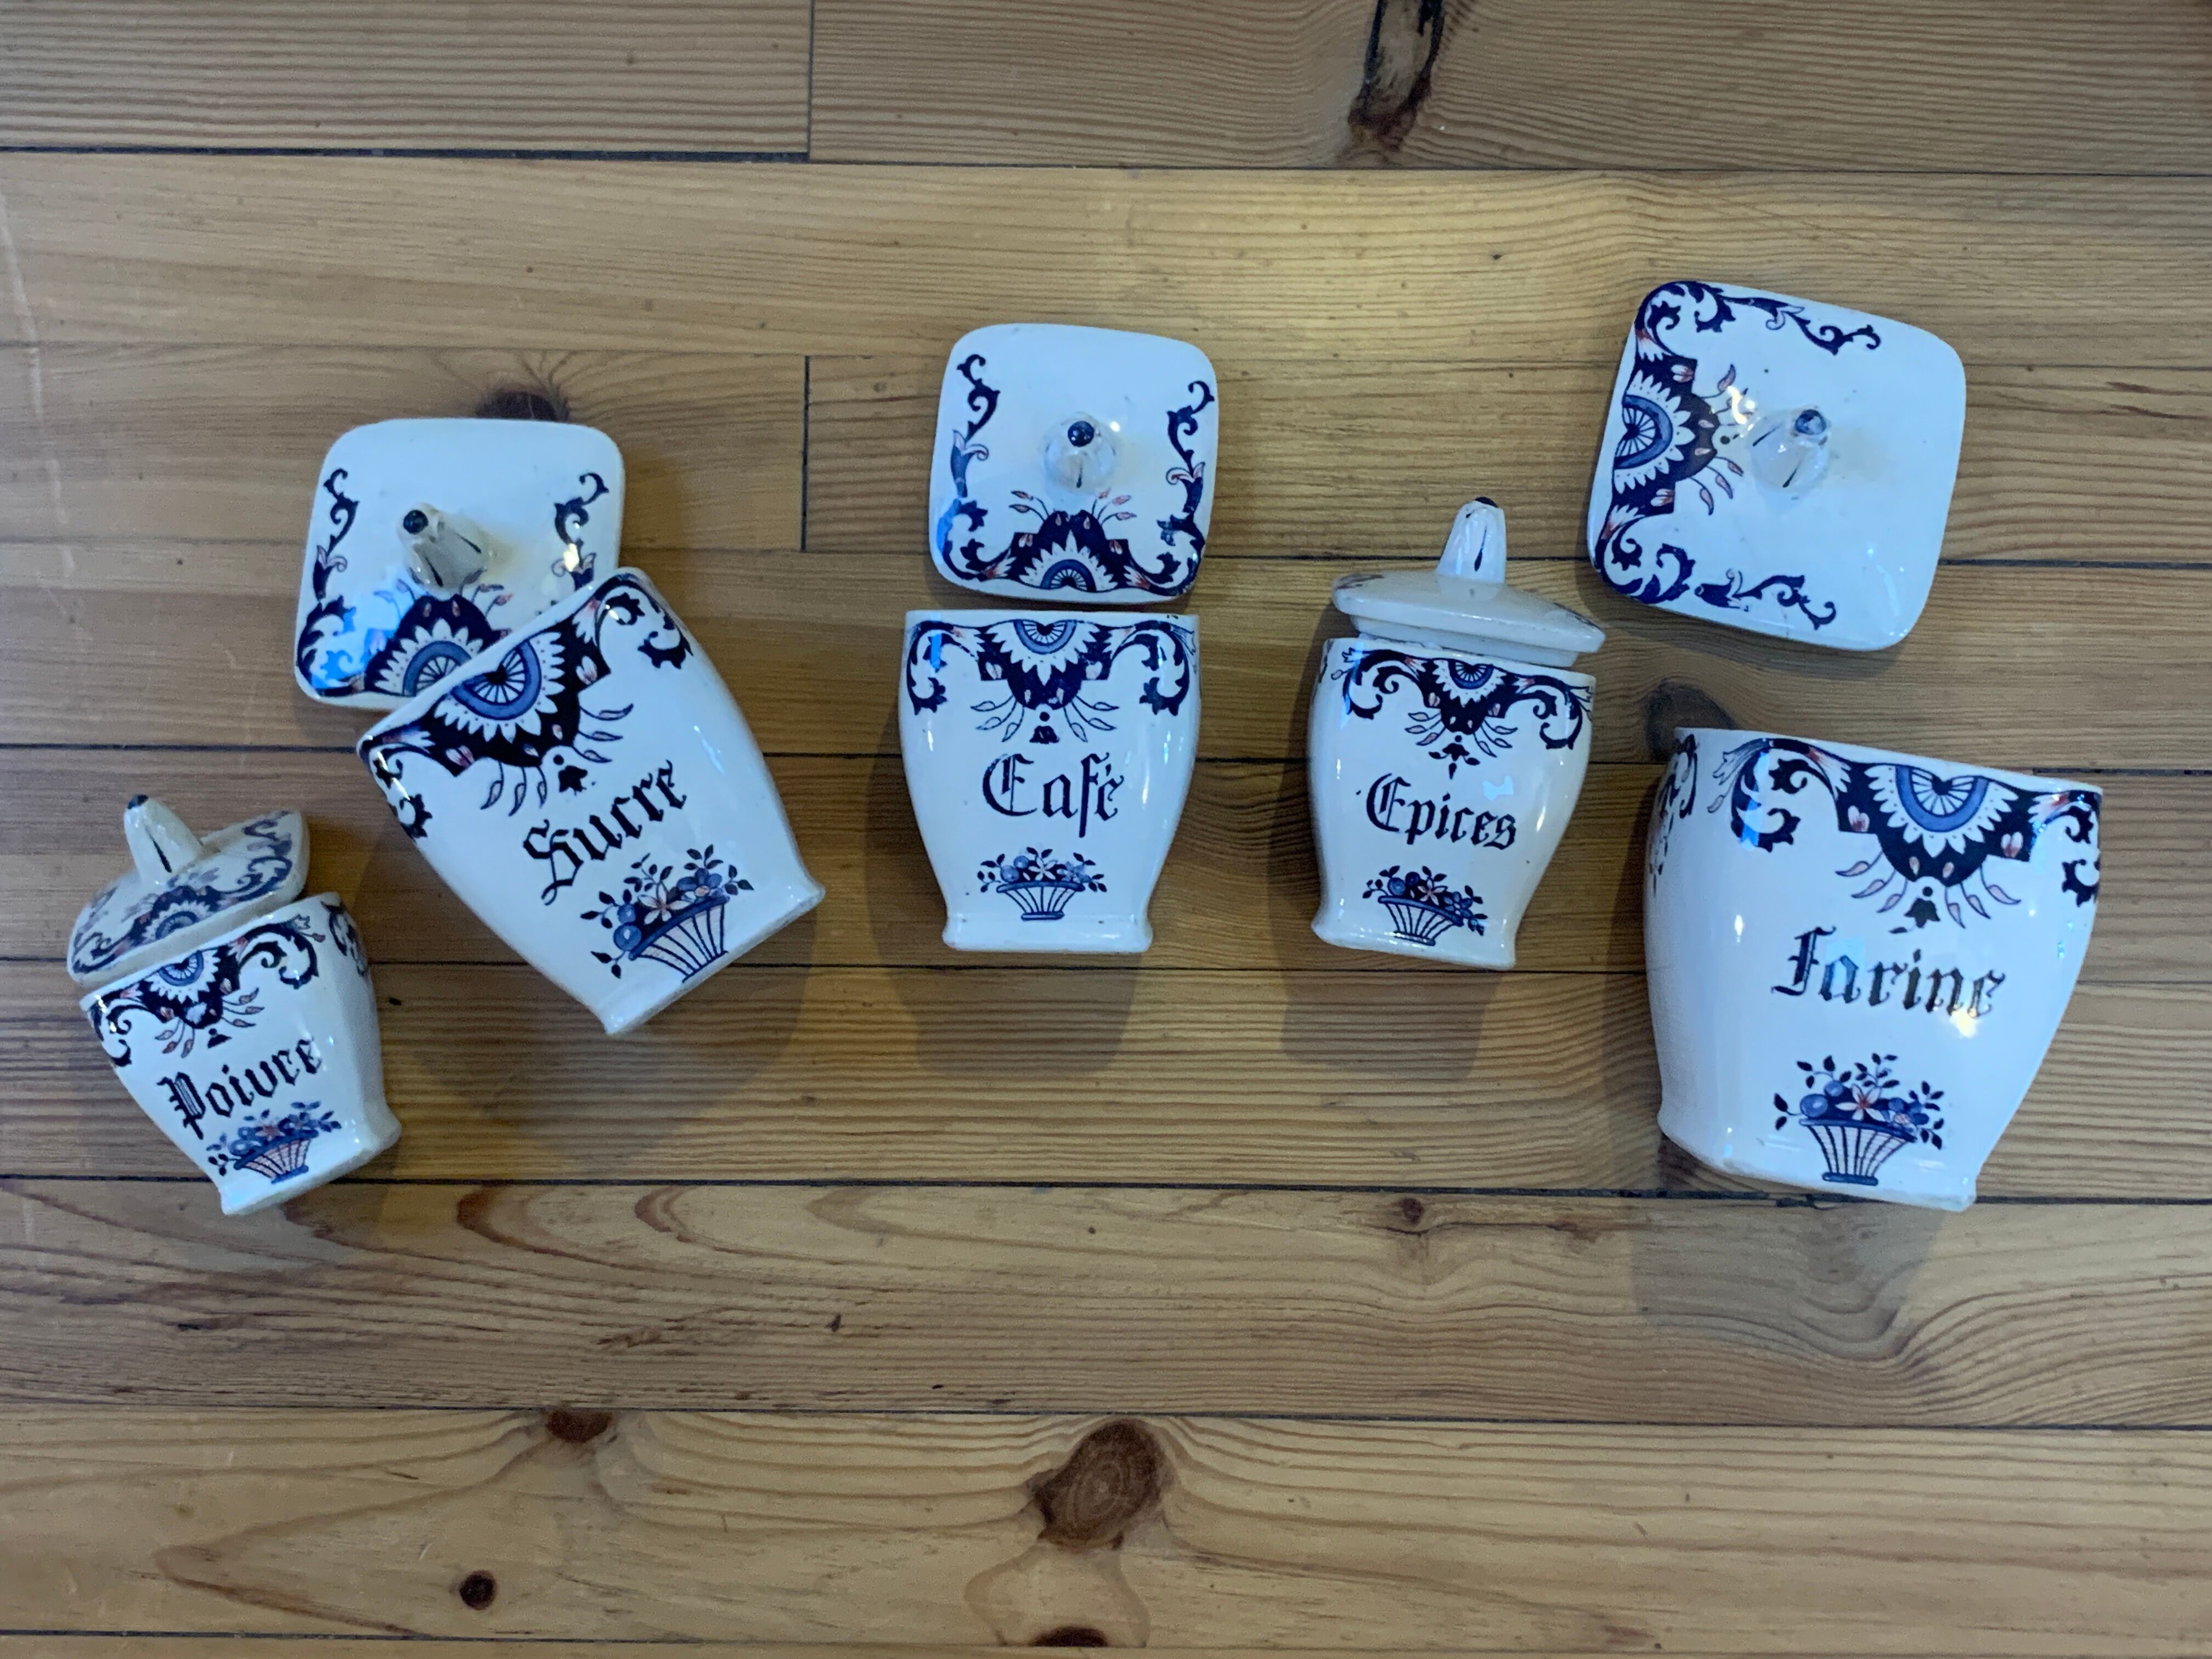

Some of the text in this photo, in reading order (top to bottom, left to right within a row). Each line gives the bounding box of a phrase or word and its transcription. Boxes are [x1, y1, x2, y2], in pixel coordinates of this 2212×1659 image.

[523, 759, 687, 906] Sucre
[983, 752, 1124, 838] Café
[1367, 773, 1516, 850] Epices
[1771, 926, 2006, 1018] Farine
[156, 1036, 323, 1139] Poivre
